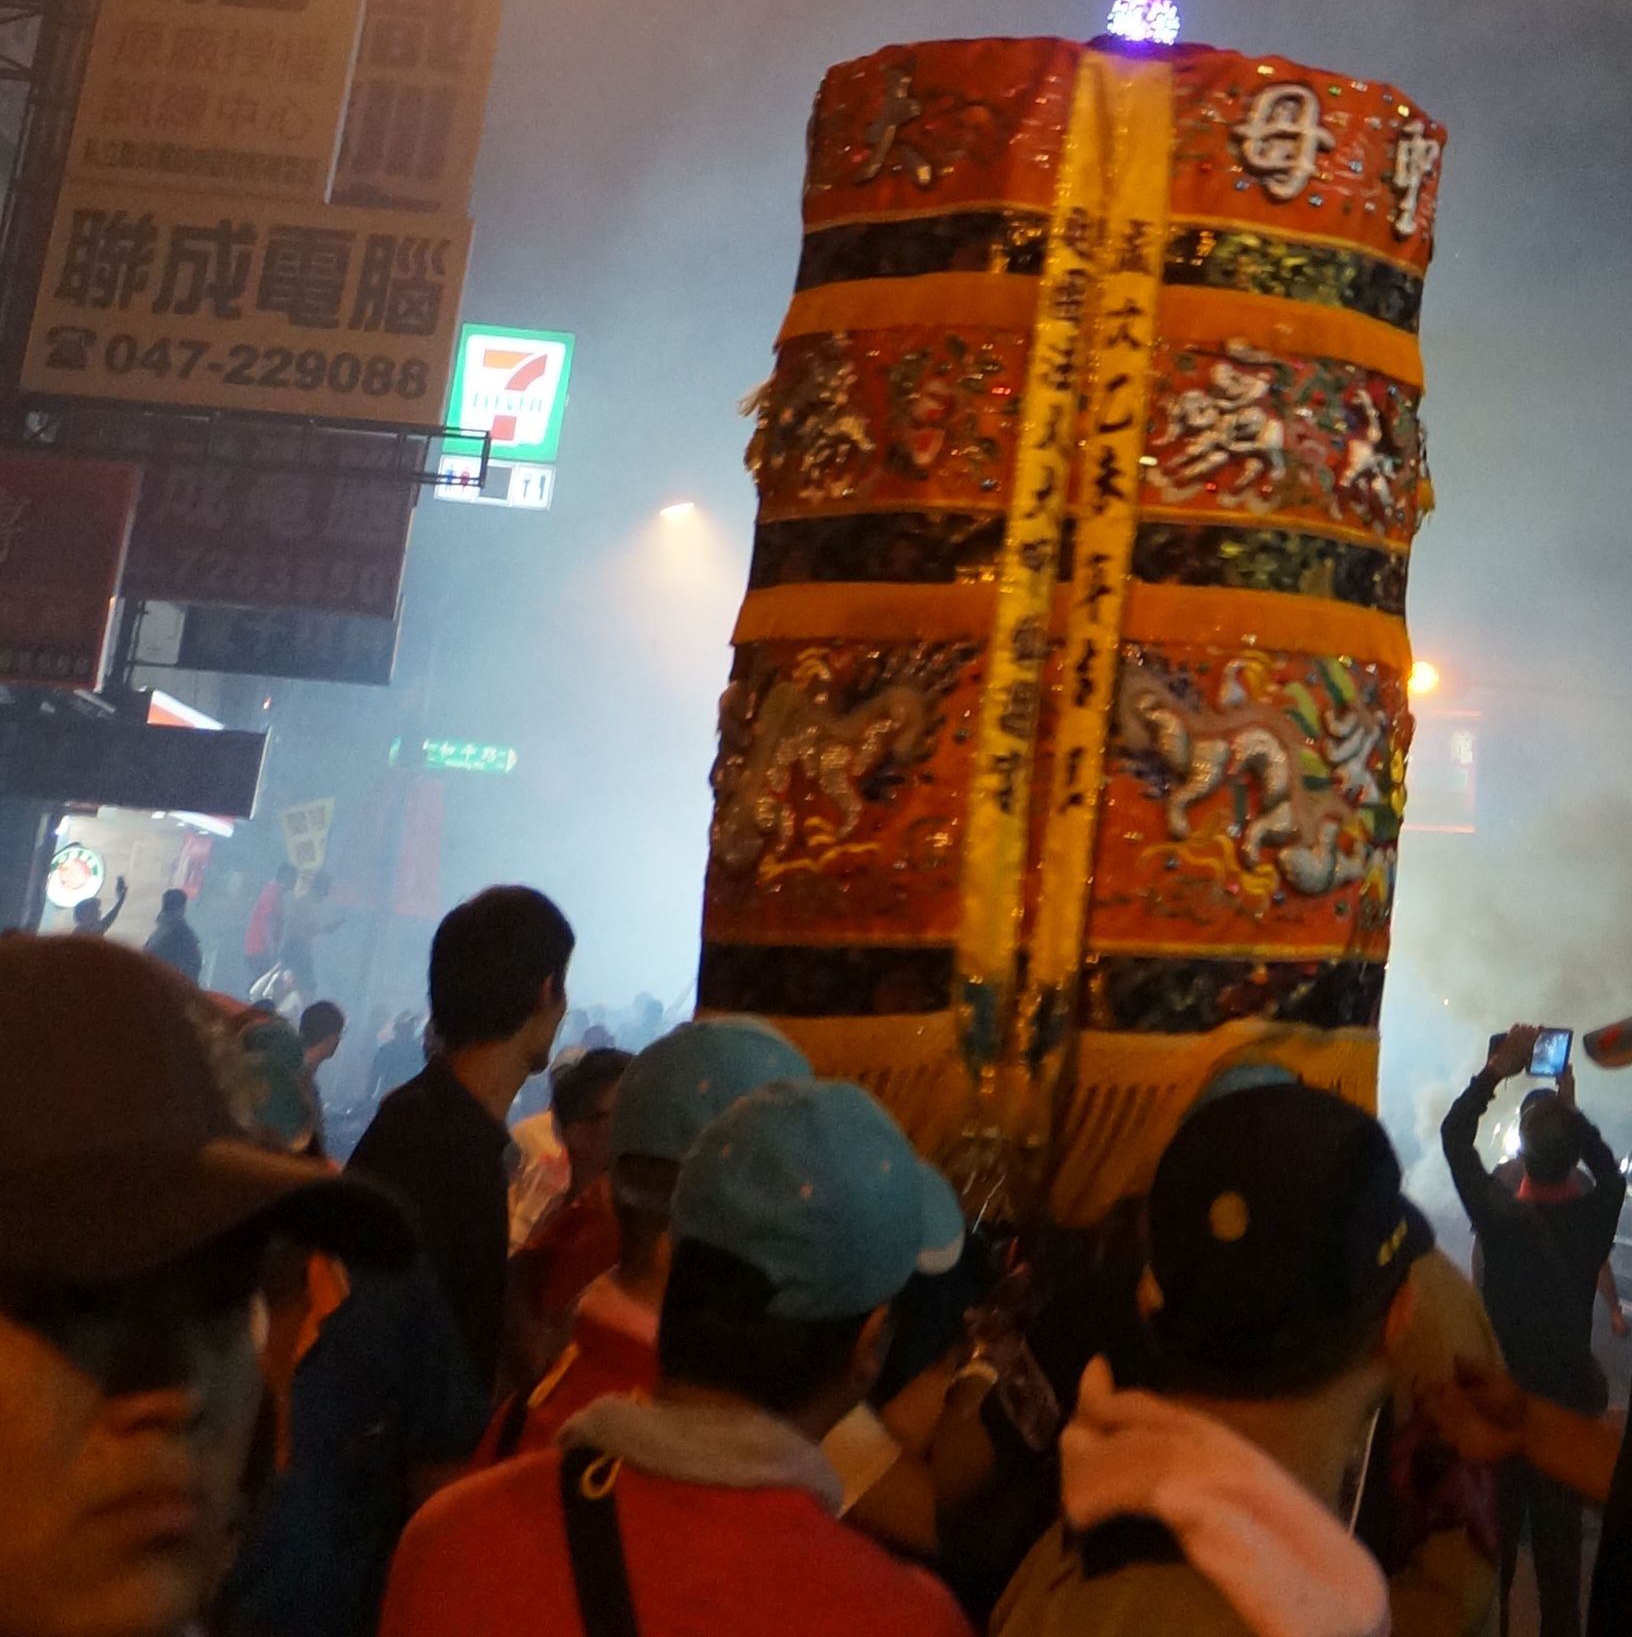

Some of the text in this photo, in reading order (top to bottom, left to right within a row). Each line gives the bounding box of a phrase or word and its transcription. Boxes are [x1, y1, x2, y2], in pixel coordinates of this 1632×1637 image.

[54, 207, 451, 336] 聯成電腦
[104, 332, 430, 400] 047-229088
[482, 347, 549, 442] 7
